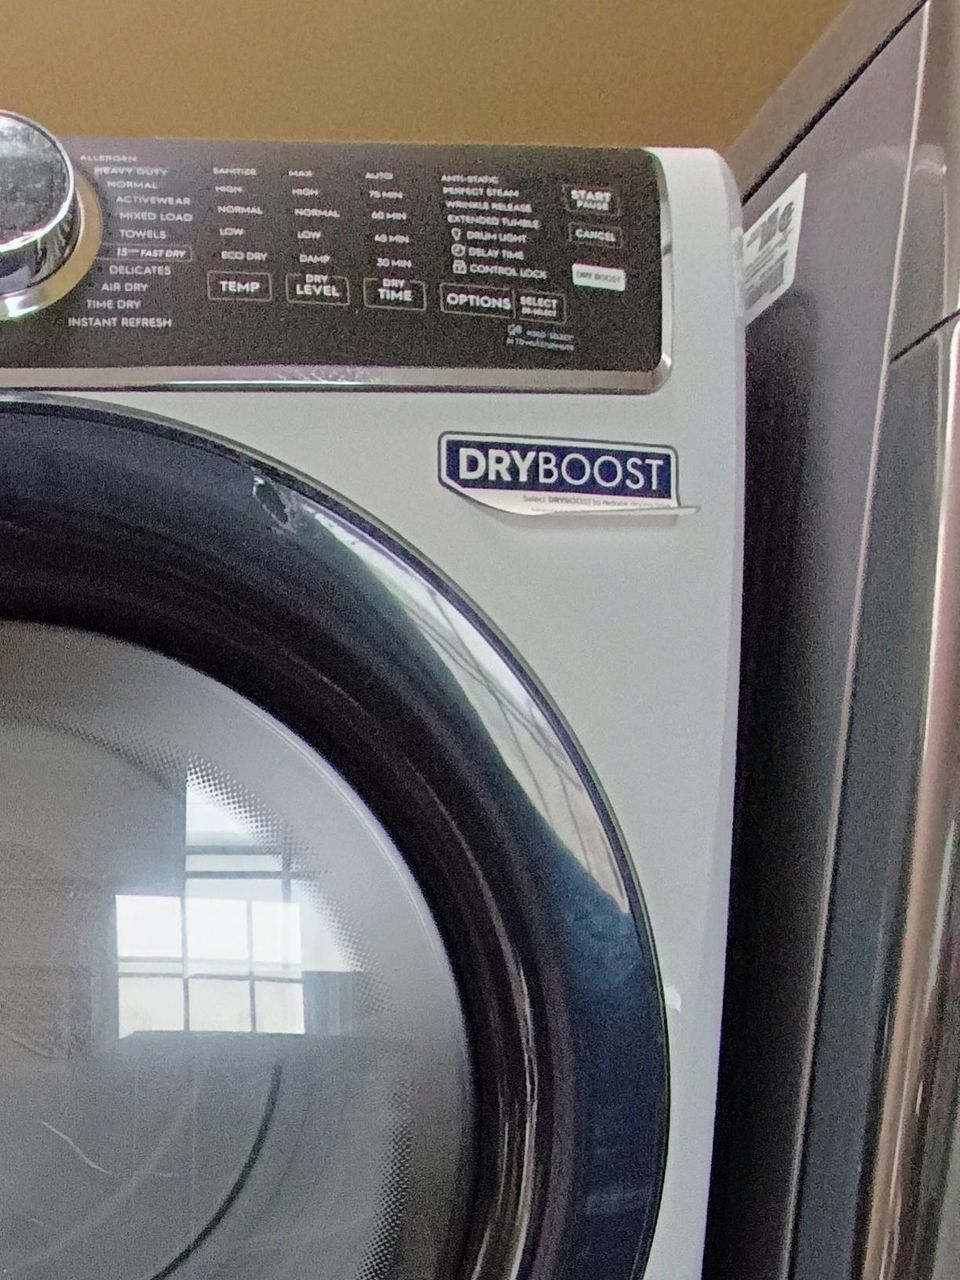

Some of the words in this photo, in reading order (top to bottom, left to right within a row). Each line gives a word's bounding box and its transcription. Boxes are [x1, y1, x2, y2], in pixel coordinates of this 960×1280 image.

[94, 167, 133, 176] HEAVY
[136, 168, 168, 176] DUTY
[213, 167, 257, 176] SANITIZE
[288, 169, 313, 178] MAX
[365, 172, 394, 180] AUTO
[107, 180, 158, 189] NORMAL
[215, 185, 242, 194] HIGH
[291, 188, 319, 197] HIGH
[382, 191, 404, 199] MIN
[443, 187, 484, 196] PERFECT
[486, 188, 519, 198] STEAM
[571, 189, 612, 201] START
[115, 196, 191, 206] ACTIVEWEAR
[576, 200, 610, 211] PAUSE
[217, 205, 263, 215] NORMAL
[446, 201, 490, 211] WRINKLE
[492, 203, 532, 213] RELEASE
[119, 211, 157, 221] MIXED
[160, 212, 193, 222] LOAD
[294, 208, 340, 218] NORMAL
[386, 212, 407, 220] MIN
[447, 214, 499, 226] EXTENDED
[501, 217, 540, 229] TUMBLE
[119, 229, 167, 239] TOWELS
[219, 227, 244, 236] LOW
[297, 231, 322, 240] LOW
[575, 228, 616, 242] CANCEL
[389, 235, 410, 244] MIN
[466, 230, 497, 241] DRUM
[499, 233, 527, 244] LIGHT
[140, 249, 164, 258] FAST
[165, 249, 187, 259] DRY
[221, 250, 244, 260] ECO
[246, 252, 268, 262] DRY
[468, 247, 499, 258] DELAY
[502, 249, 524, 260] TIME
[299, 254, 330, 264] DAMP
[391, 259, 412, 268] MIN
[109, 265, 171, 276] DELICATES
[470, 264, 518, 276] CONTROL
[520, 267, 547, 279] LOCK
[305, 274, 329, 284] DRY
[382, 278, 406, 288] DRY
[101, 283, 122, 292] AIR
[124, 283, 149, 292] DRY
[219, 280, 260, 293] TEMP
[296, 284, 340, 297] LEVEL
[378, 288, 412, 301] TIME
[86, 300, 116, 309] TIME
[117, 300, 141, 310] DRY
[446, 292, 512, 310] OPTIONS
[520, 296, 558, 309] SELECT
[68, 317, 118, 327] INSTANT
[121, 317, 172, 328] REFRESH
